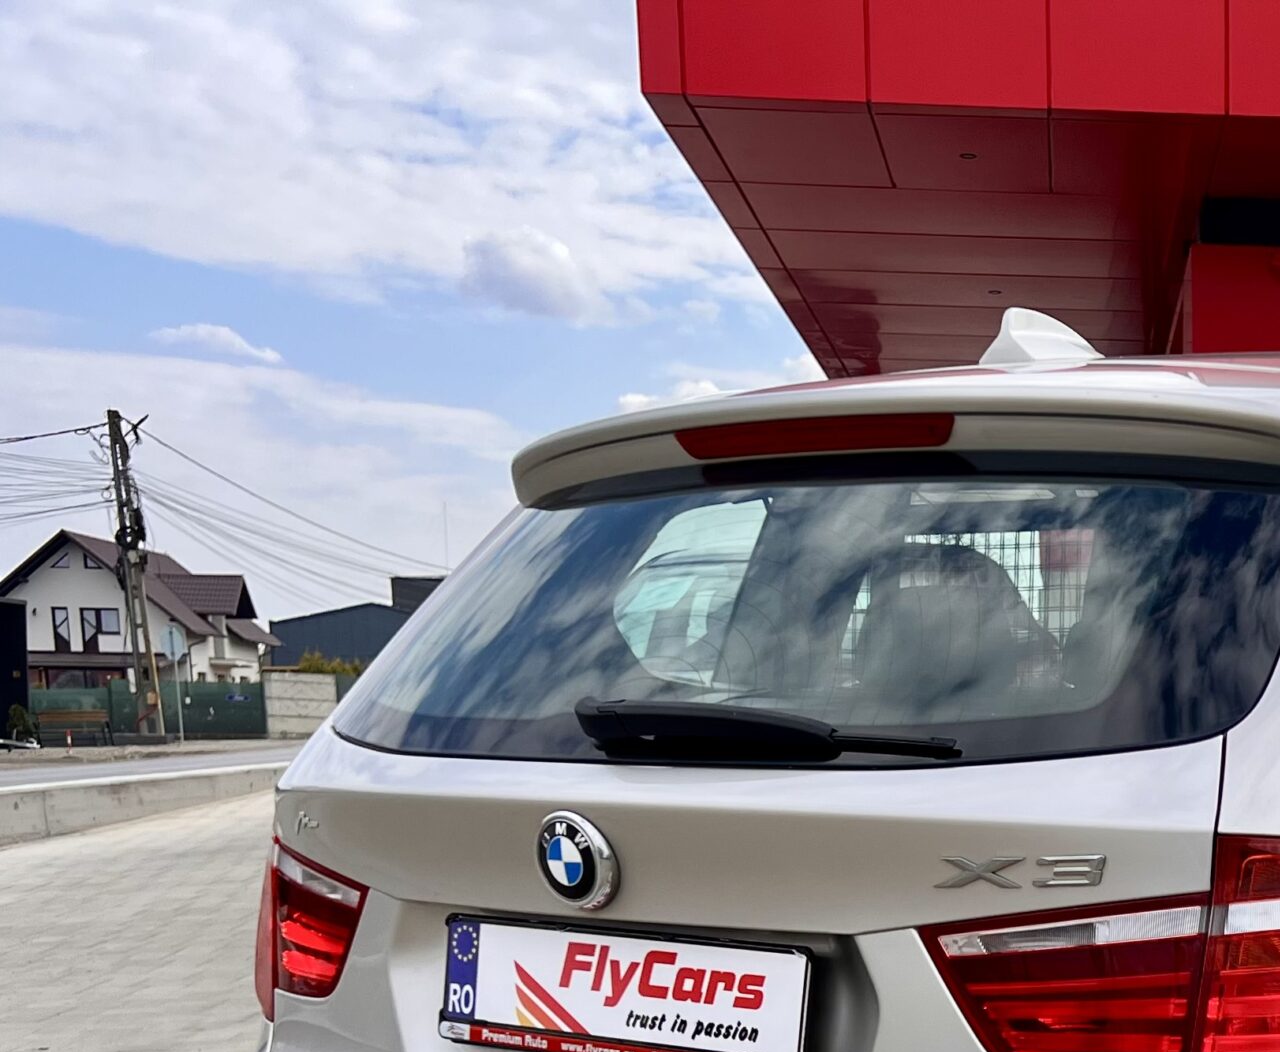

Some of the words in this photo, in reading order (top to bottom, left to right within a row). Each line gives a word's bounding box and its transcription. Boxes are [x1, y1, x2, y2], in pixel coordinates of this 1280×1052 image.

[933, 854, 1107, 889] X3
[559, 941, 766, 1010] FlyCars
[448, 983, 474, 1015] RO
[482, 1029, 523, 1046] Premium
[525, 1034, 548, 1049] Auto
[626, 1010, 666, 1031] trust
[670, 1013, 687, 1034] in
[691, 1020, 759, 1043] passion
